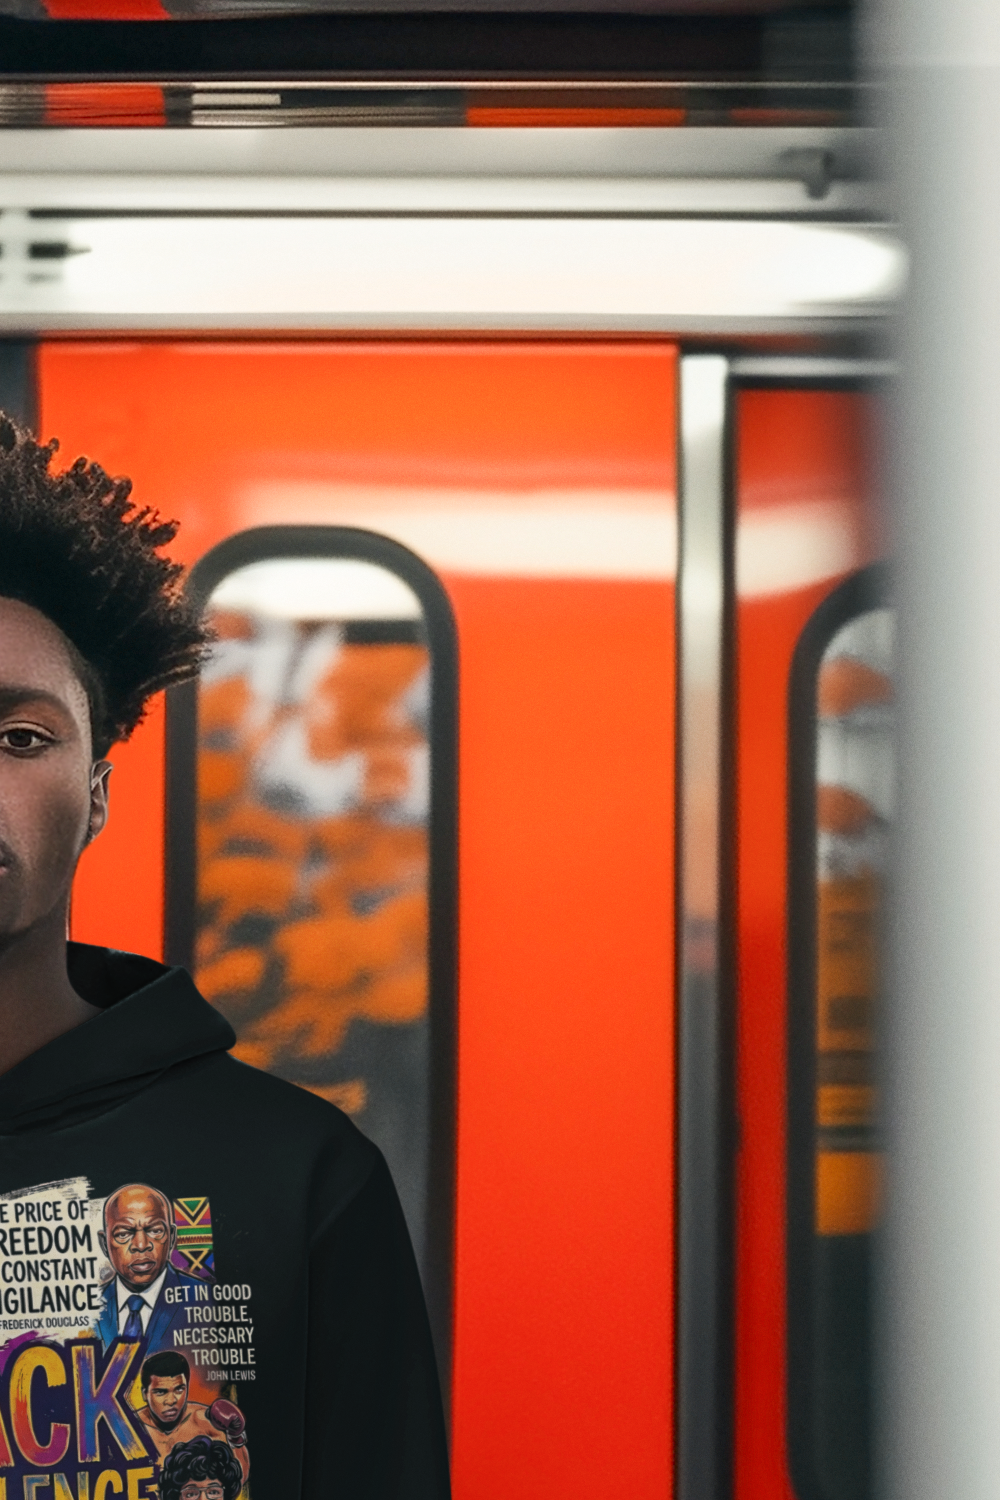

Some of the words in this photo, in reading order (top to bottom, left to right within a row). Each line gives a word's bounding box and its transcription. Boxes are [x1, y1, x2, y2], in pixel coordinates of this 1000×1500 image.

[15, 1201, 63, 1223] PRICE
[68, 1200, 89, 1220] OF
[2, 1257, 97, 1283] CONSTANT
[165, 1286, 190, 1303] GET
[194, 1285, 209, 1301] IN
[213, 1284, 251, 1300] GOOD
[46, 1316, 89, 1327] DOUGLASS
[184, 1305, 253, 1323] TROUBLE,
[173, 1327, 254, 1346] NECESSARY
[192, 1348, 256, 1366] TROUBLE
[206, 1371, 228, 1381] JOHN
[230, 1370, 255, 1381] LEWIS
